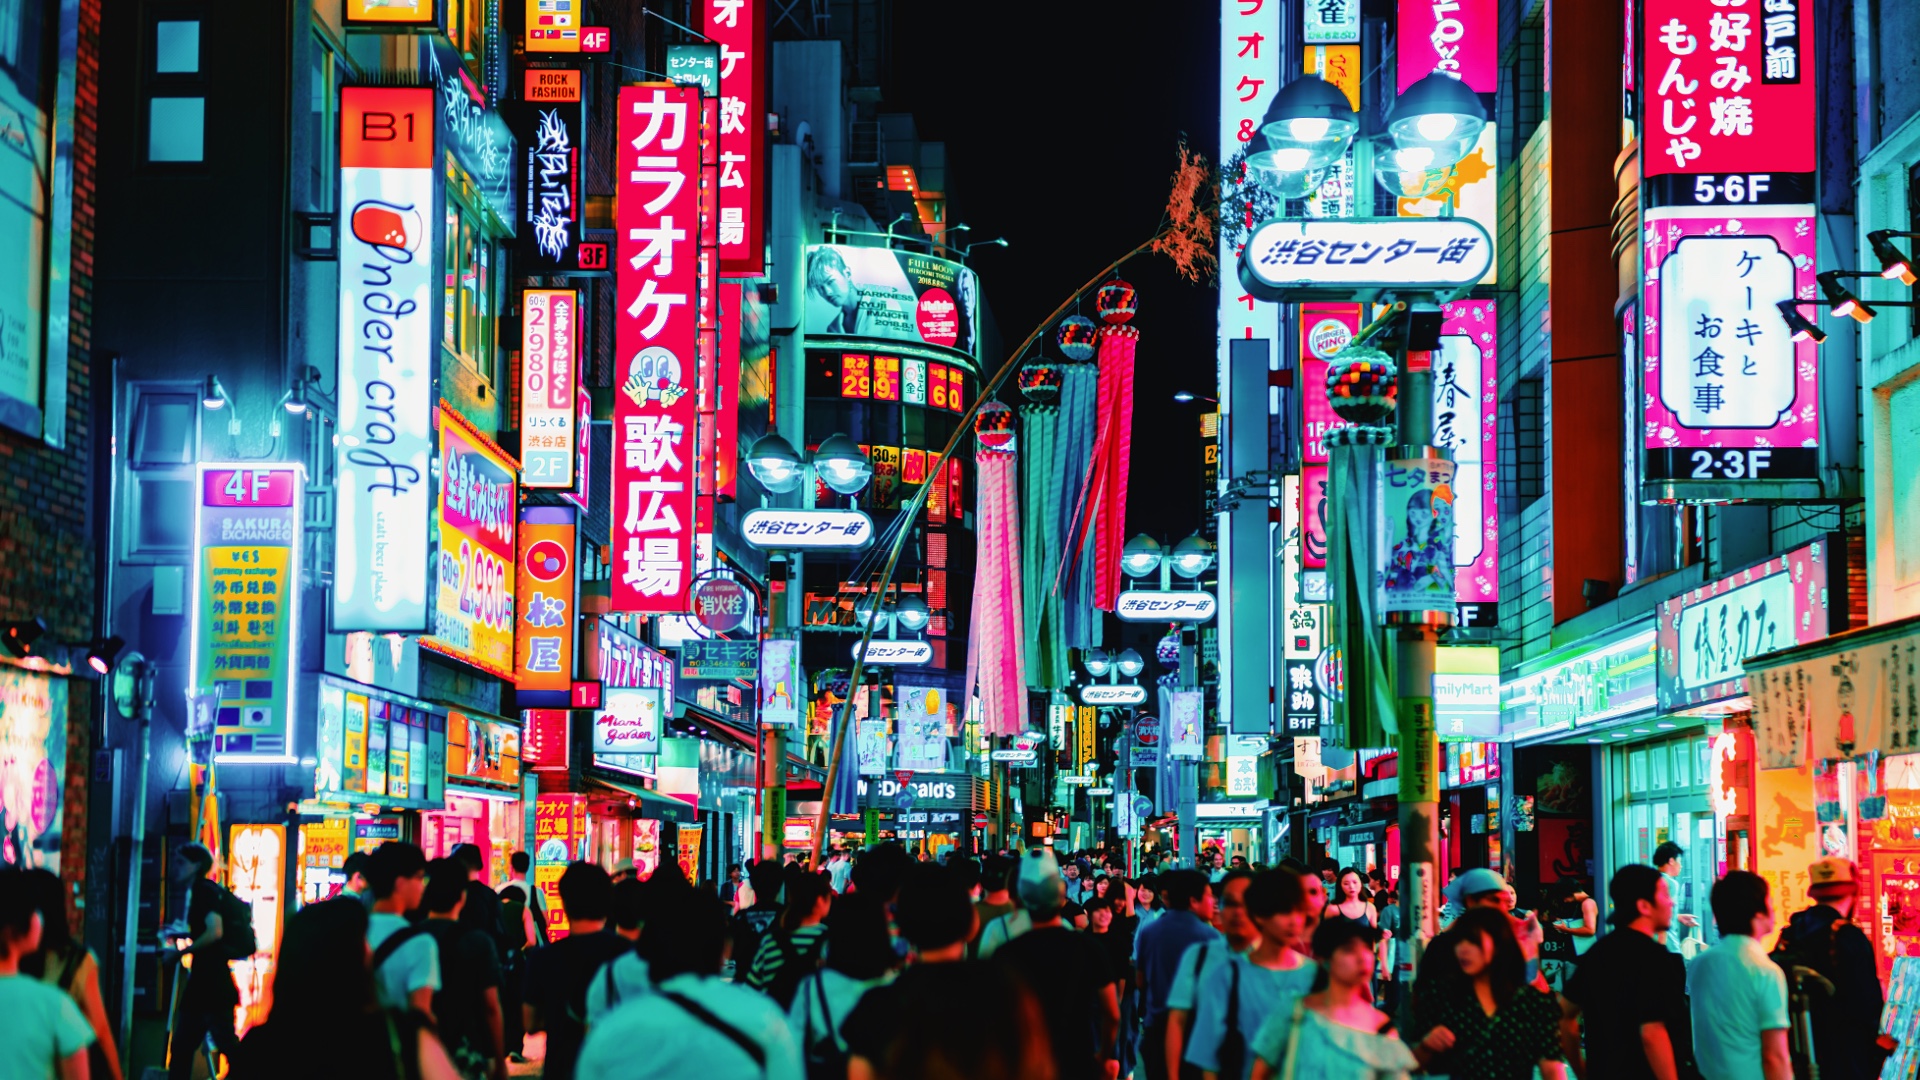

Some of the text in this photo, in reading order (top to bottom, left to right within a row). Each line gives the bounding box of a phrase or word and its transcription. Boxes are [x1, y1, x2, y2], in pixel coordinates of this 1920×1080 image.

[583, 33, 606, 48] 4F
[670, 57, 714, 68] センター街
[1709, 0, 1753, 136] 好み焼
[540, 74, 568, 85] ROCK
[532, 87, 575, 98] FASHION
[1658, 18, 1701, 168] もんじゃ
[362, 112, 414, 142] B1
[627, 90, 687, 340] カラオケ
[583, 247, 604, 265] 3F
[1260, 238, 1480, 265] 渋谷センター街
[908, 258, 931, 270] FULL
[529, 296, 545, 306] 60分
[857, 290, 914, 302] DARKNESS
[867, 311, 908, 320] IMAICHI
[1736, 250, 1763, 376] ケーキと
[874, 319, 914, 329] 2018.8.1
[1316, 328, 1345, 342] BURGER
[1316, 337, 1346, 351] KING
[552, 300, 570, 405] 全身もみほぐし
[1693, 313, 1726, 415] お食事
[529, 417, 566, 428] りらくる
[347, 380, 419, 497] craft
[528, 436, 566, 447] 渋谷店
[873, 449, 897, 462] 30分
[532, 457, 563, 476] 2F
[224, 470, 269, 502] 4F
[623, 414, 684, 597] 歌広場
[222, 517, 292, 530] SAKURA
[748, 520, 865, 536] 渋谷センター街
[222, 530, 283, 540] EXCHANGE
[442, 552, 459, 590] 60分
[699, 595, 743, 615] 消火栓
[1122, 600, 1212, 611] 渋谷センター街
[212, 620, 240, 635] 외화
[524, 592, 566, 672] 松屋
[702, 643, 758, 660] セキネ
[857, 647, 927, 657] 谷センター街
[214, 655, 270, 669] 外貨両替
[579, 686, 597, 704] 1F
[1085, 690, 1141, 698] 渋谷センター街
[1436, 683, 1493, 698] milyMart
[596, 715, 643, 727] Miami
[1289, 718, 1316, 729] B1F
[1451, 719, 1463, 732] 酒
[857, 780, 955, 799] MDald's
[536, 801, 569, 816] ラオケ
[536, 818, 568, 833] 広場
